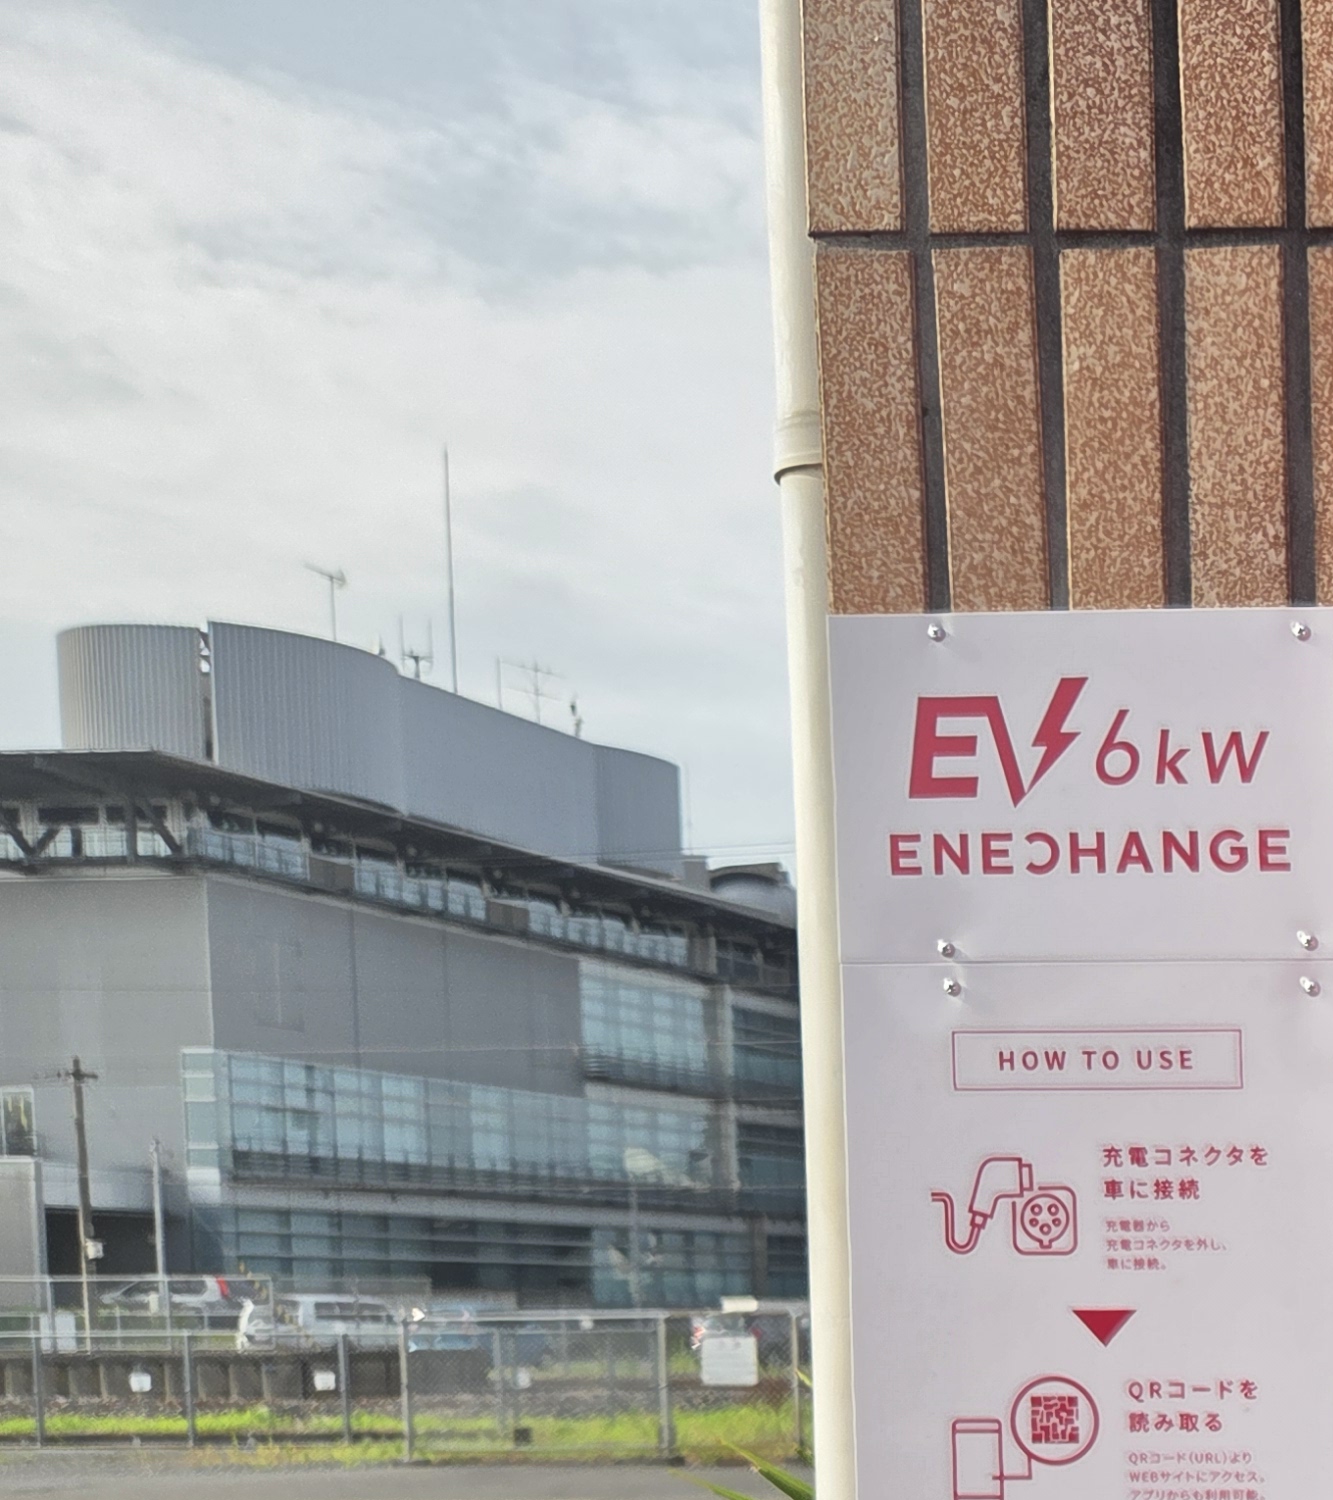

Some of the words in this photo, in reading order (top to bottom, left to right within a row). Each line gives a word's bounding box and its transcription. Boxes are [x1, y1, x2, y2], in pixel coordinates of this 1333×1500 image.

[1095, 709, 1270, 785] 6kW
[889, 829, 1291, 876] ENECHANGE
[999, 1050, 1067, 1071] HOW
[1083, 1050, 1120, 1070] TO
[1137, 1049, 1193, 1070] USE
[1102, 1146, 1269, 1167] 充電コネクタを
[1103, 1179, 1201, 1200] 車に接続
[1106, 1219, 1170, 1233] 充電器から
[1106, 1238, 1228, 1252] 充電コネクタを外し、
[1106, 1257, 1167, 1271] 車に接続。
[1128, 1380, 1259, 1402] QRコードを
[1129, 1412, 1223, 1433] 読み取る
[1129, 1470, 1265, 1483] WEBサイトにアクセス。
